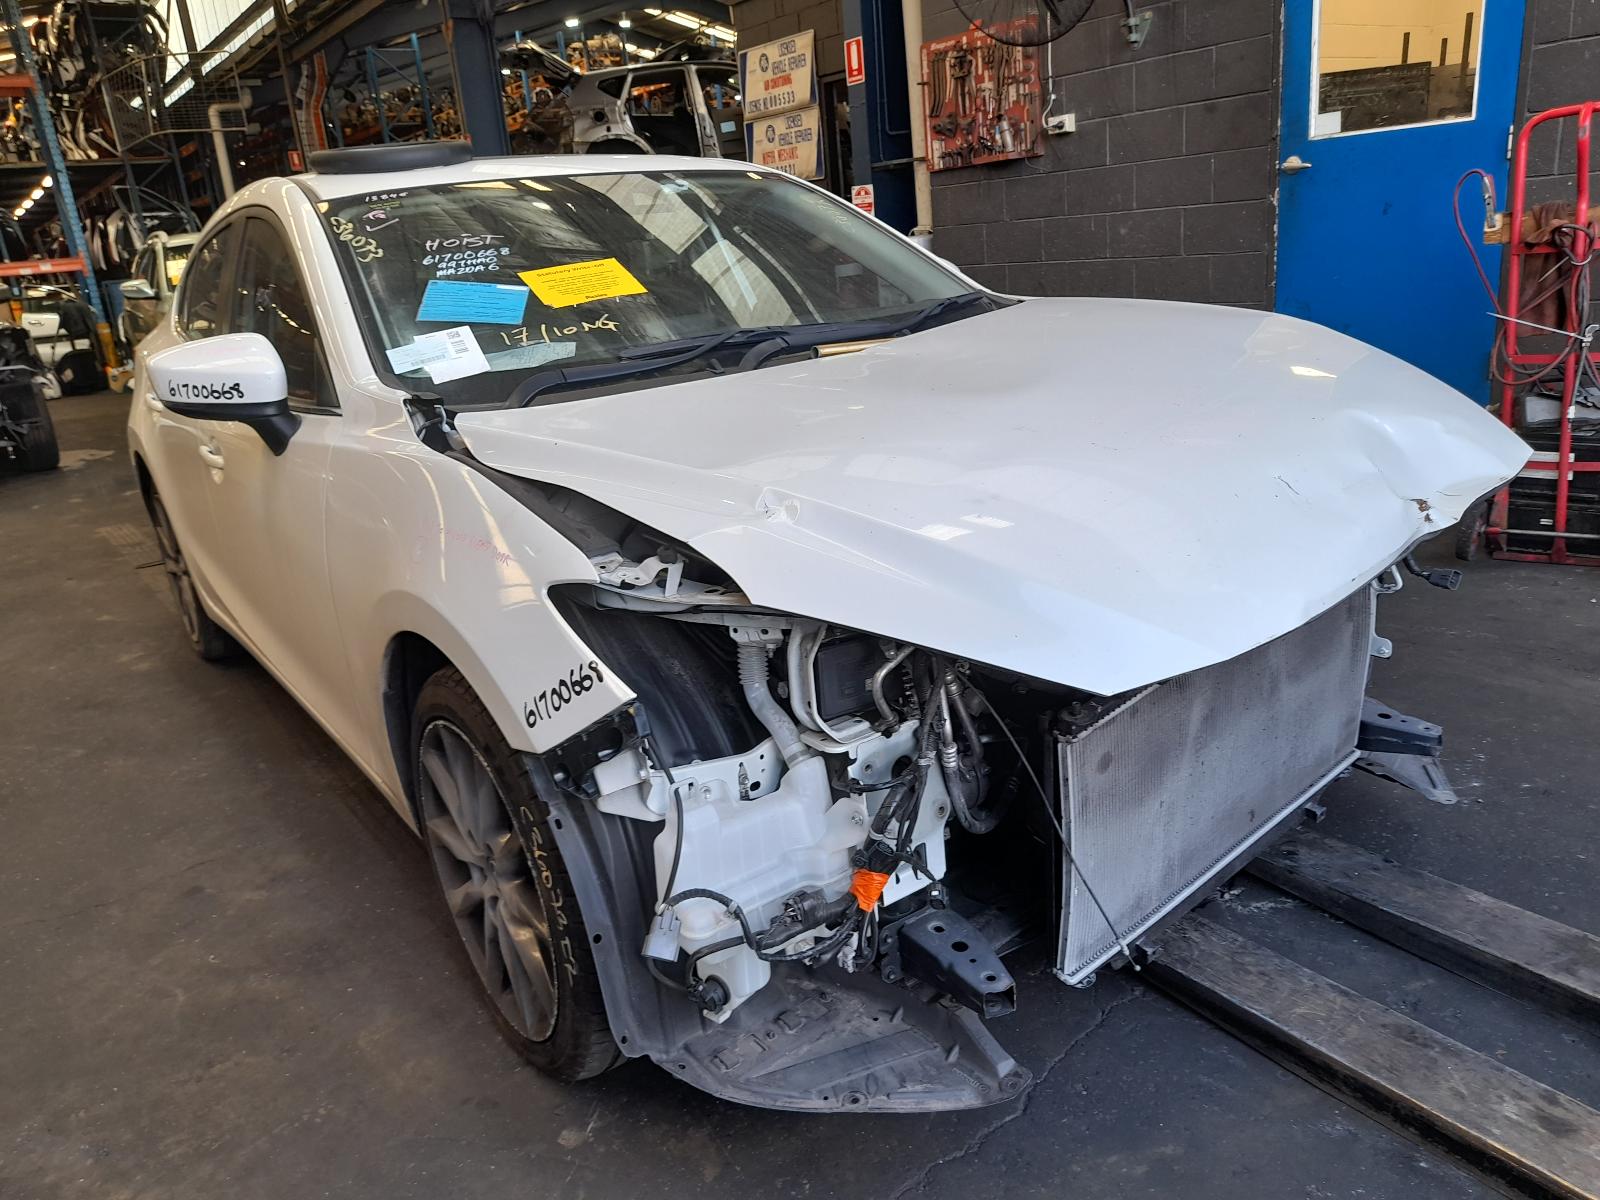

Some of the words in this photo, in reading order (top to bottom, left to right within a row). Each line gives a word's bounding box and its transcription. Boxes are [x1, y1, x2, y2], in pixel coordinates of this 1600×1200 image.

[425, 233, 504, 251] HOIST
[422, 247, 510, 265] 61700668
[168, 379, 244, 400] 61700668
[524, 660, 604, 728] 61700668
